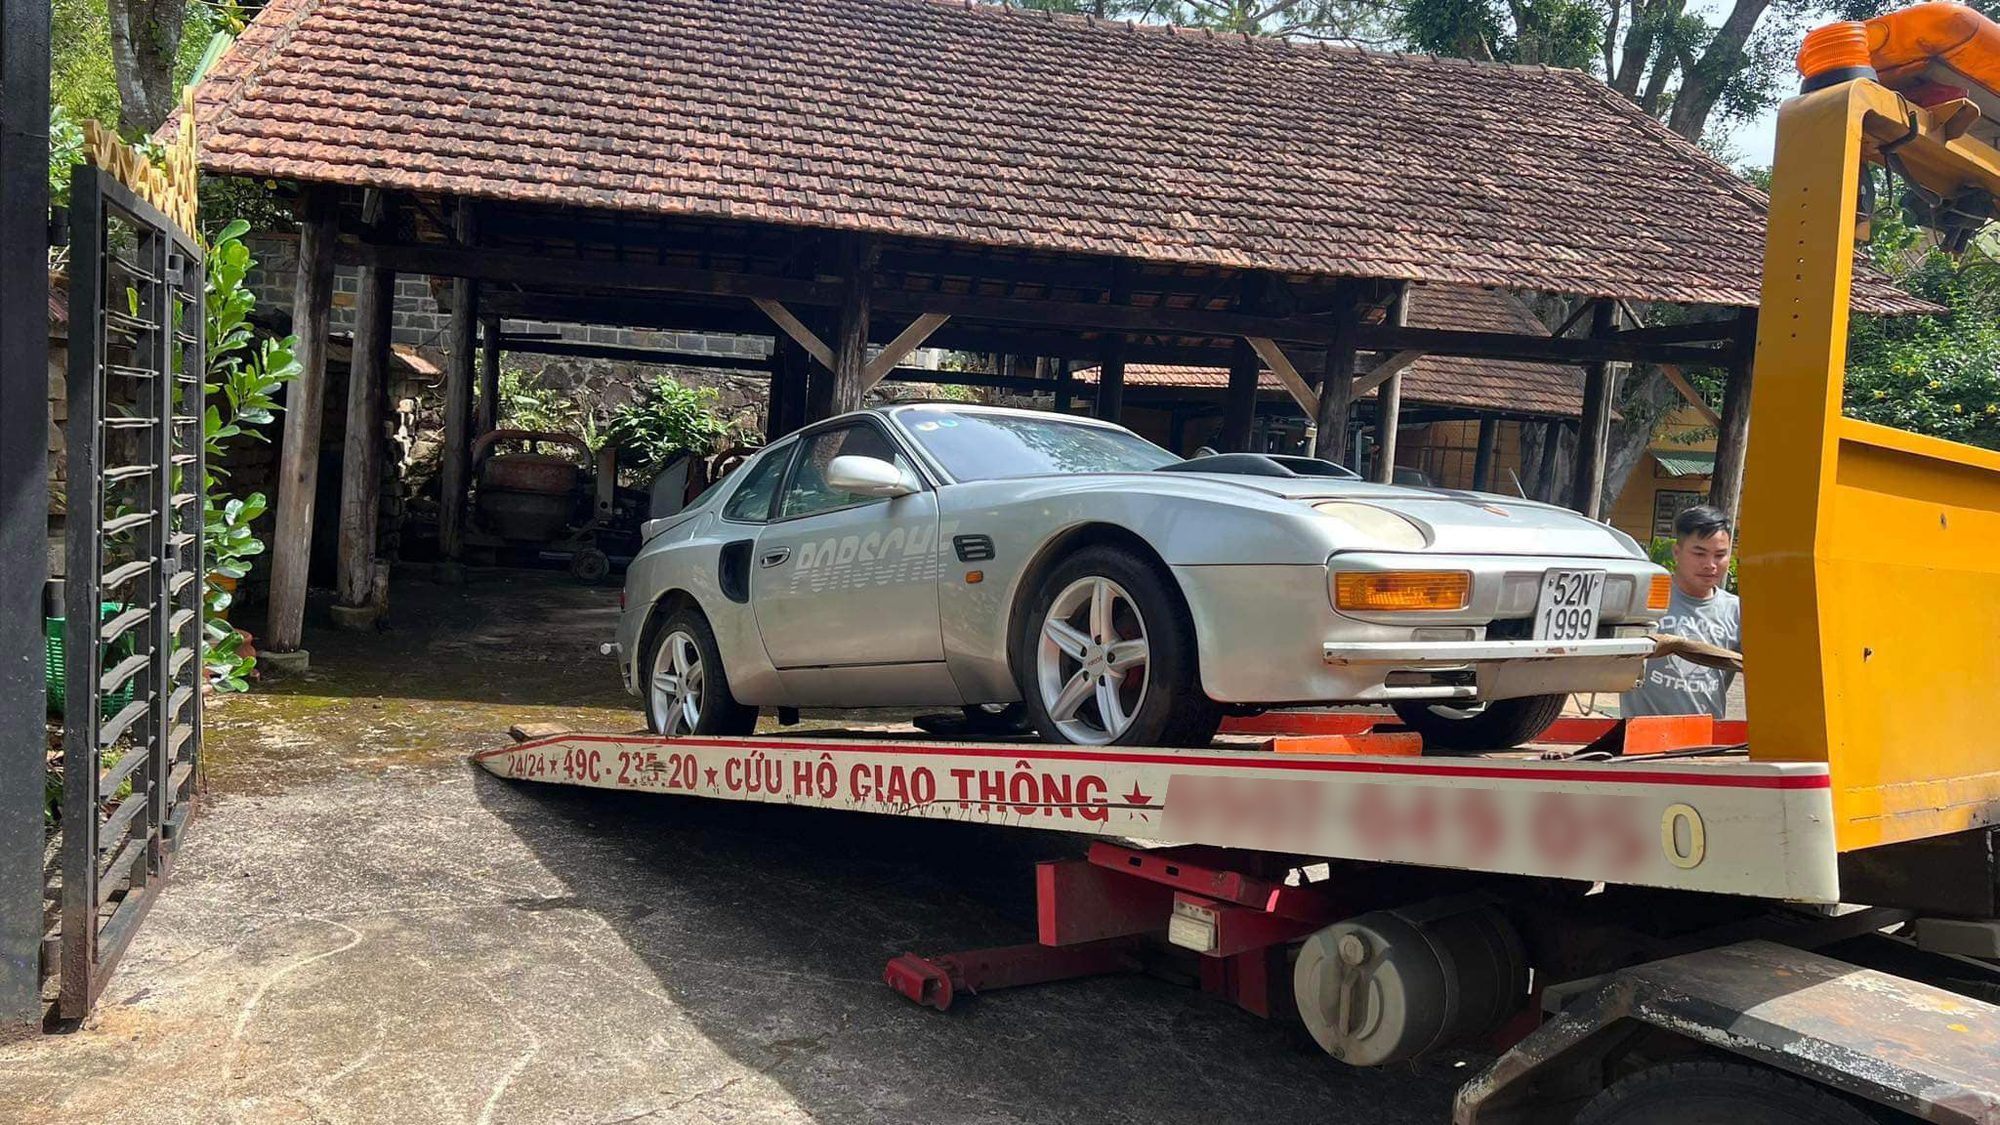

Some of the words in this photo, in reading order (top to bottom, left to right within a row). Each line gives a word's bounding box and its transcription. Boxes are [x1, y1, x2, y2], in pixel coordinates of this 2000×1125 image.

[1553, 573, 1595, 606] 52N
[1544, 608, 1592, 640] 1999
[507, 752, 545, 777] 24/24
[725, 750, 782, 794] CỨU
[850, 763, 936, 804] GIAO
[950, 759, 1109, 823] THÔNG
